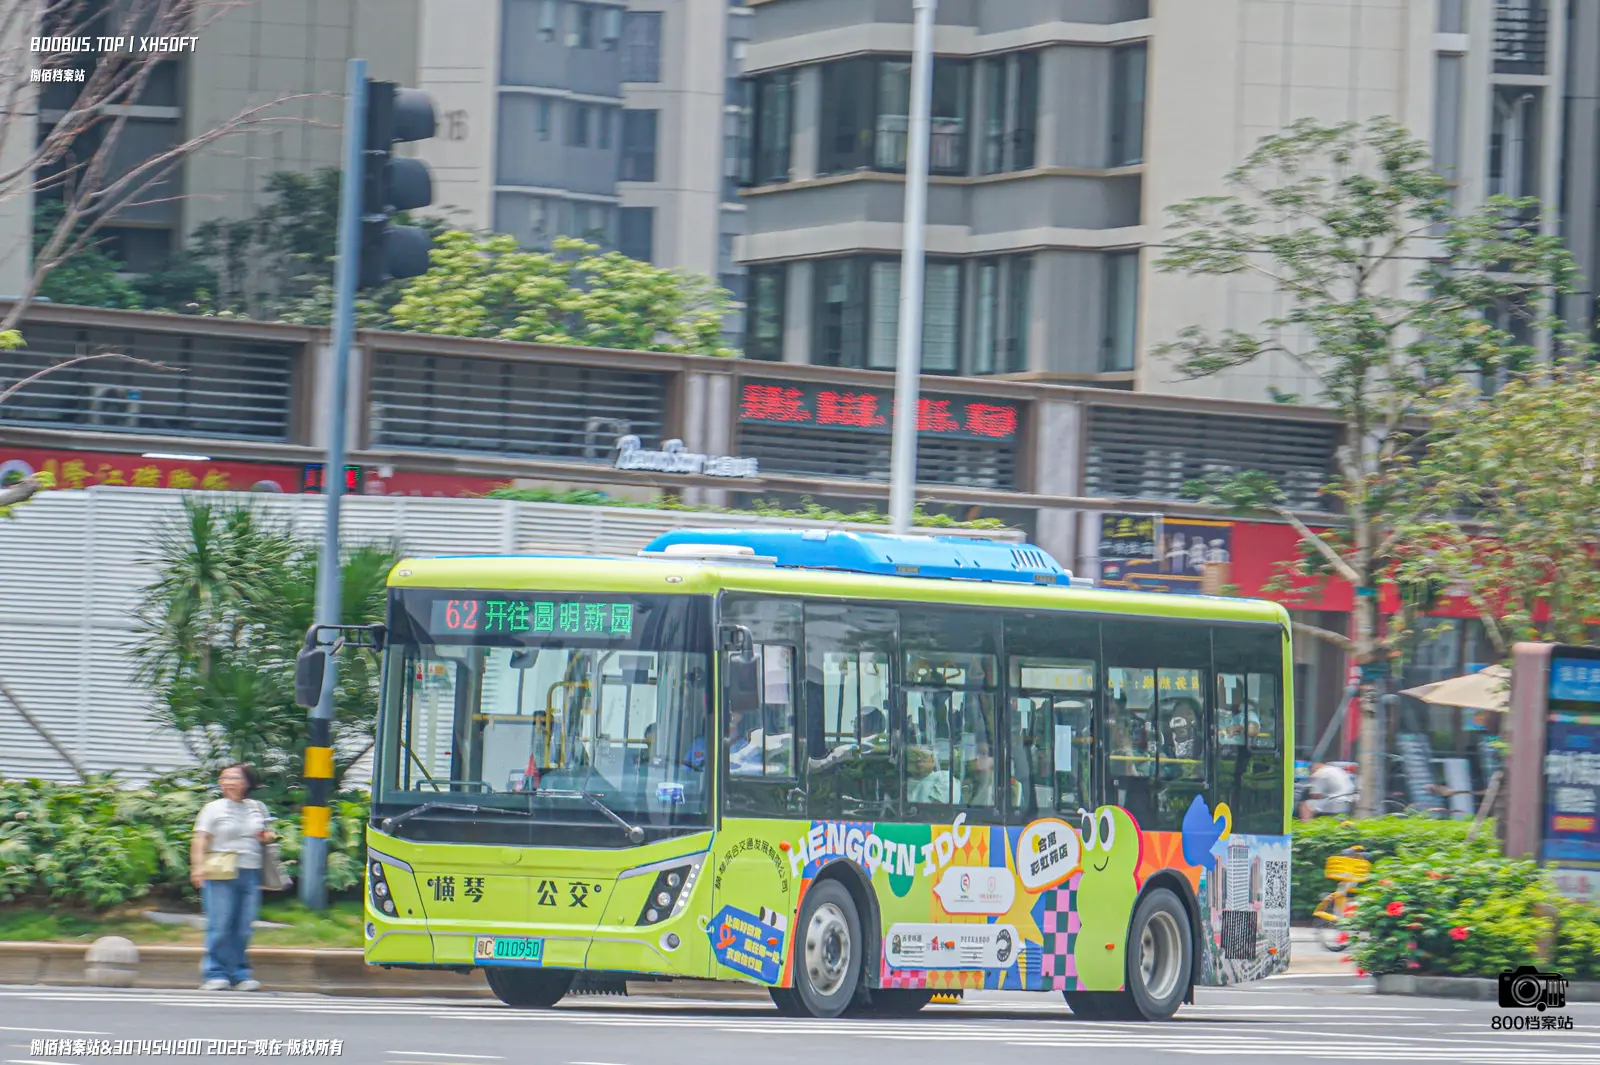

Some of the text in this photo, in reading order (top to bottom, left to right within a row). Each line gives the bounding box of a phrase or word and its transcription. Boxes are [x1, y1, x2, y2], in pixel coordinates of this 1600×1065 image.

[446, 600, 632, 633] 62 开往圆明新园
[787, 812, 972, 879] HENGQIN IDC
[434, 876, 591, 908] 横琴 公交
